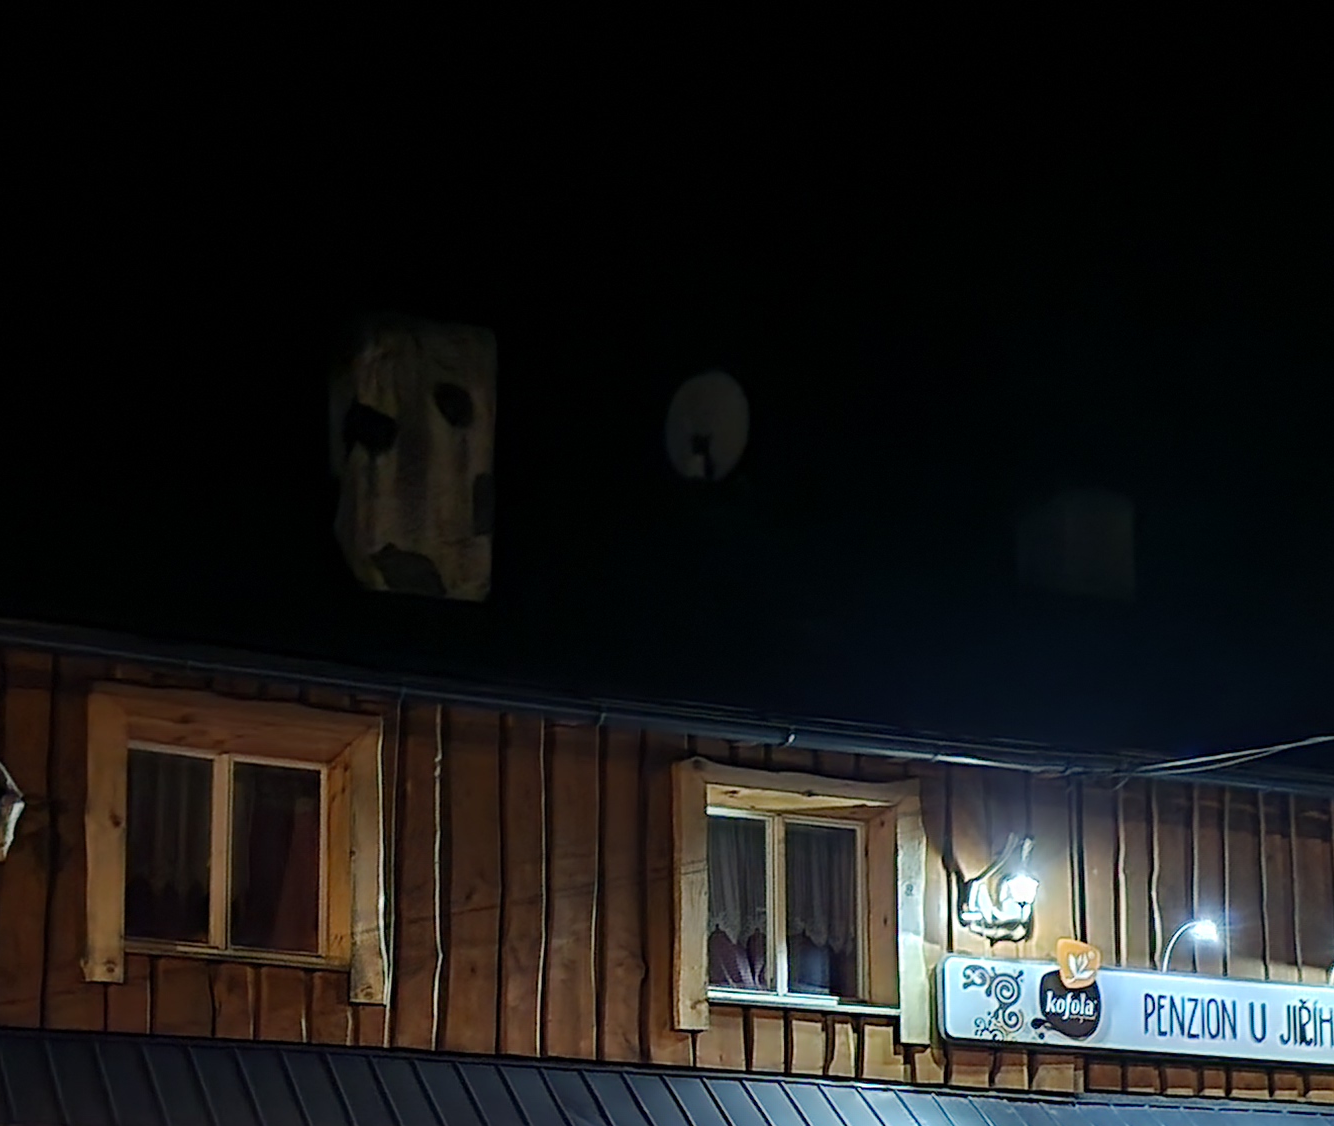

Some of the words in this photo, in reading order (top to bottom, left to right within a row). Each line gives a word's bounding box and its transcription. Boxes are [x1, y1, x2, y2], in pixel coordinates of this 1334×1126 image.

[1045, 990, 1094, 1020] kofola
[1144, 993, 1237, 1040] PENZION
[1249, 1002, 1266, 1043] U
